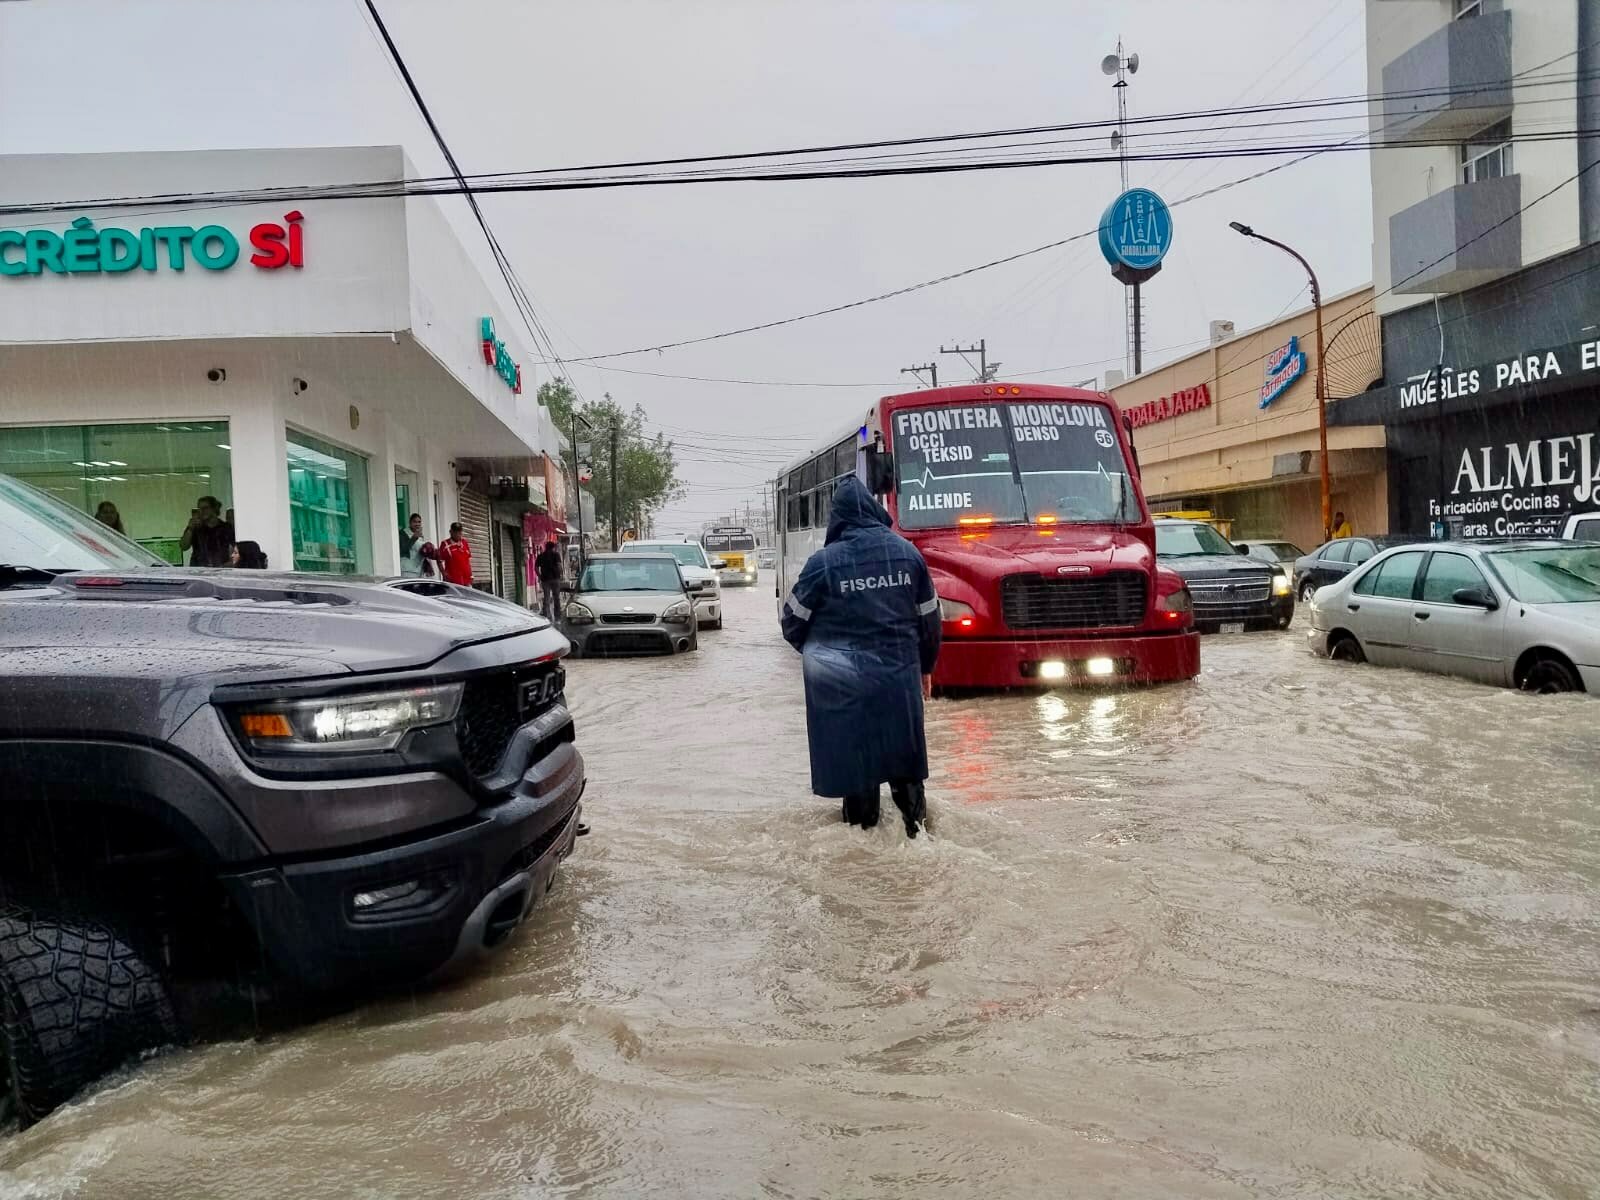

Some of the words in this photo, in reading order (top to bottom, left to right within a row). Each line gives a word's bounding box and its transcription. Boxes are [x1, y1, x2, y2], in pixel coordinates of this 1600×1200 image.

[0, 216, 240, 276] CRÉDITO
[249, 210, 305, 268] SÍ
[1400, 369, 1480, 409] MUEBLES
[1496, 351, 1562, 389] PARA
[898, 407, 1002, 435] FRONTERA
[1009, 405, 1107, 428] MONCLOVA
[909, 432, 945, 450] OCCI
[1014, 426, 1060, 442] DENSO
[1097, 433, 1113, 446] 56
[922, 445, 973, 463] TEKSID
[909, 492, 973, 511] ALLENDE
[840, 570, 911, 593] FISCALÍA
